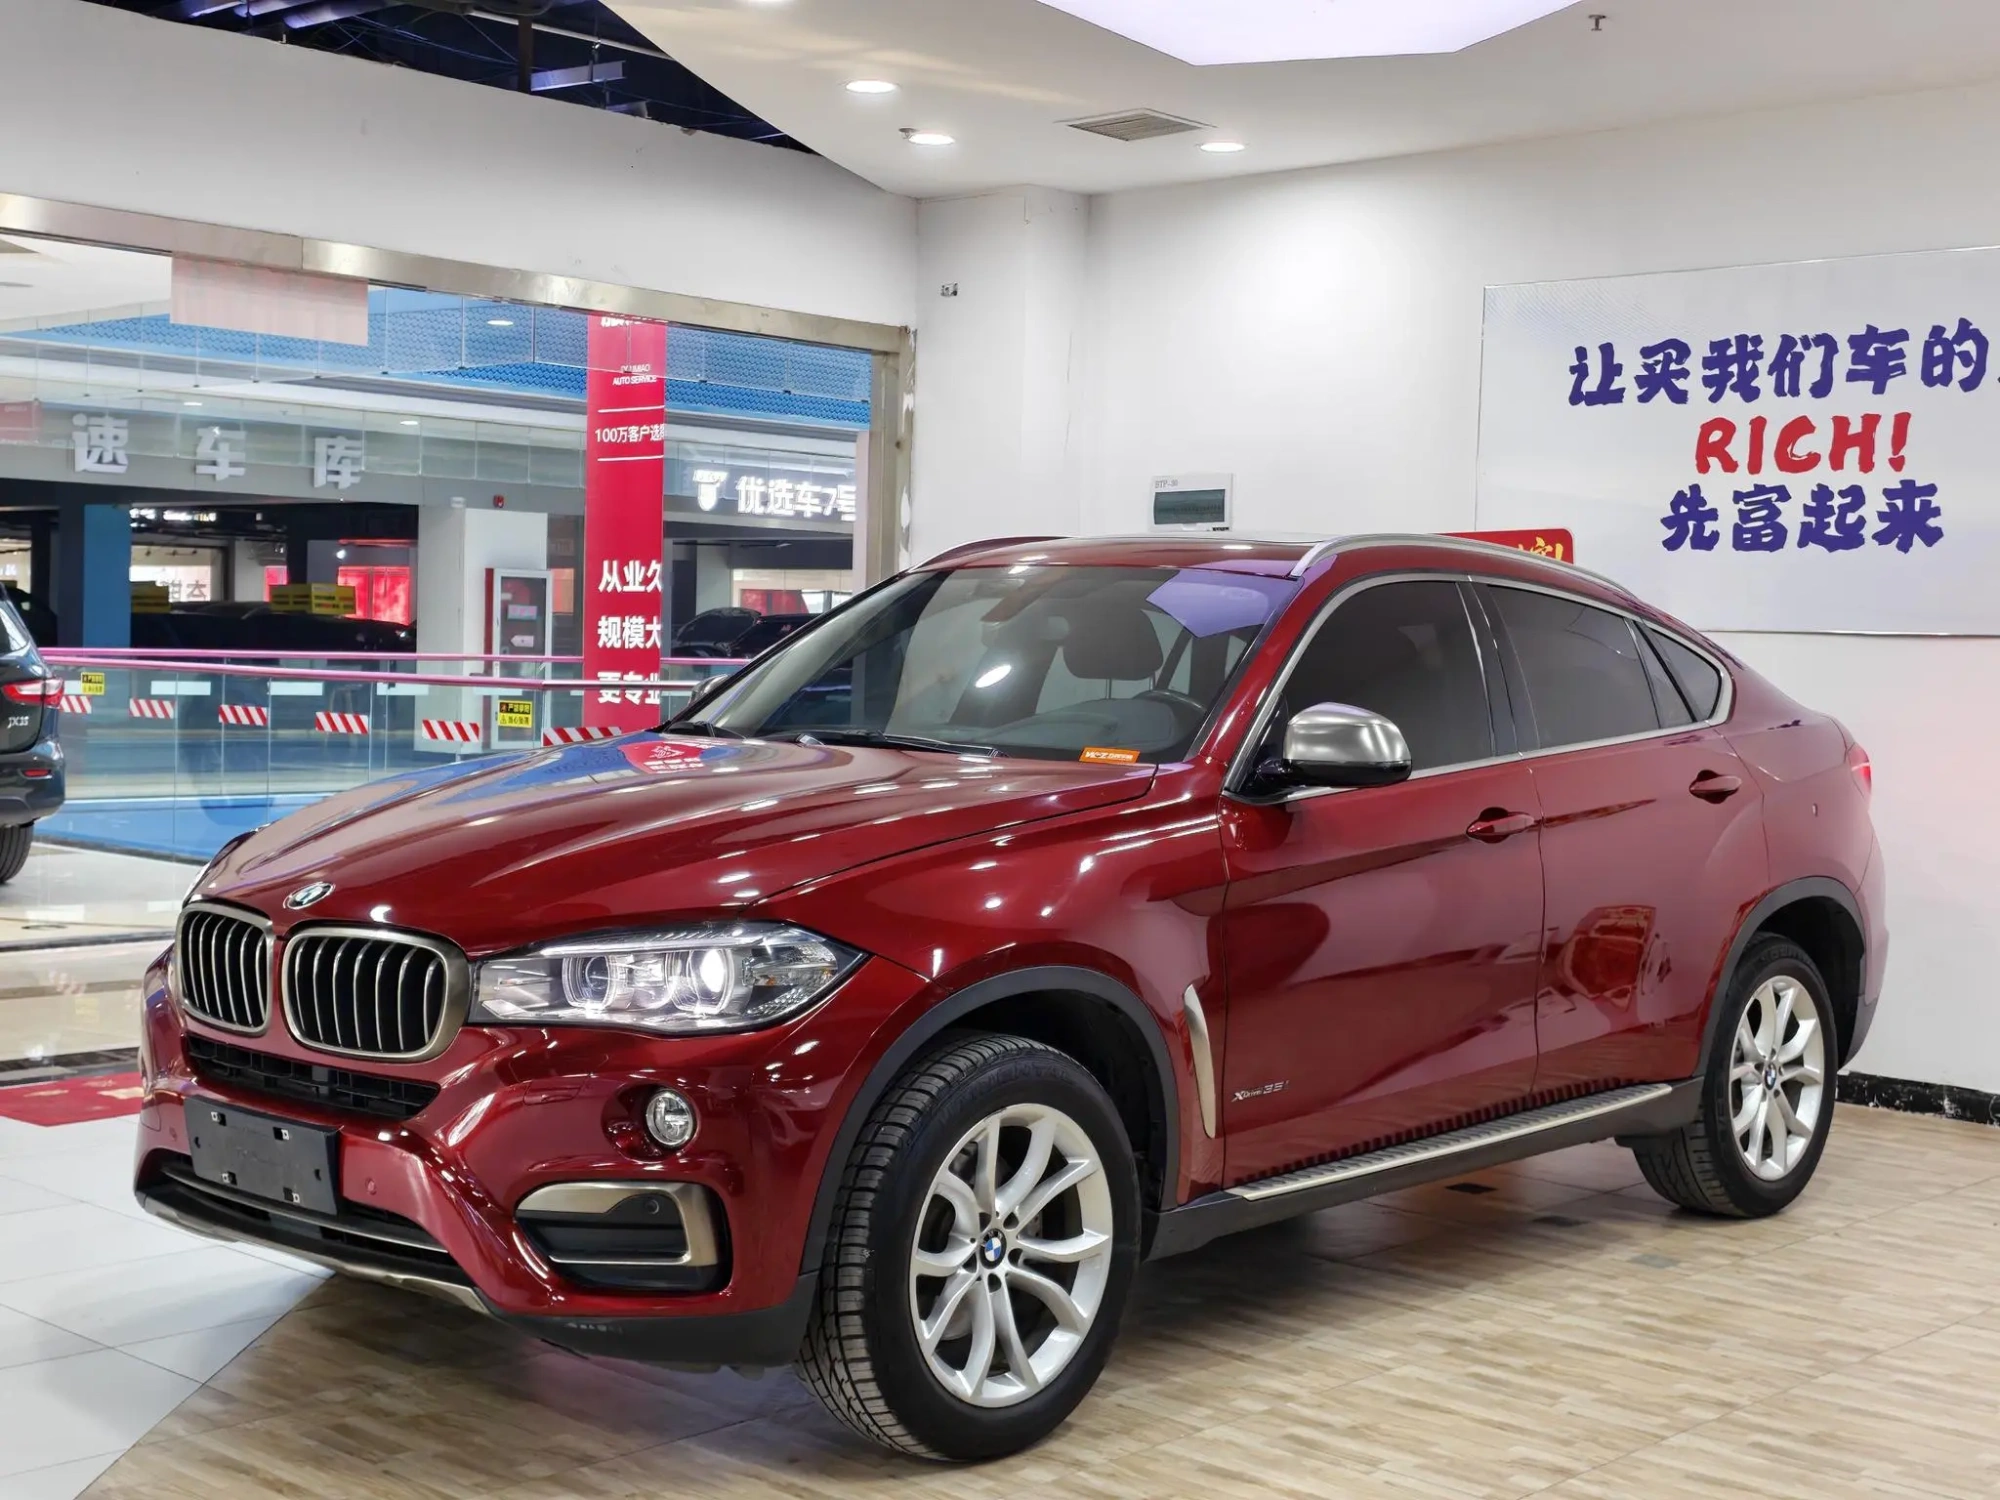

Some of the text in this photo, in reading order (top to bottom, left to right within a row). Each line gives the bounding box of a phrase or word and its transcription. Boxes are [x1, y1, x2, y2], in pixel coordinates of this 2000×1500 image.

[612, 376, 631, 386] AUTO
[1568, 317, 2000, 406] 让买我们车的
[72, 414, 362, 490] 速车库
[1695, 412, 1912, 475] RICH!
[1661, 479, 1944, 554] 先富起来
[598, 560, 662, 593] 从业久
[597, 615, 661, 649] 规模大
[597, 671, 660, 705] 更专业
